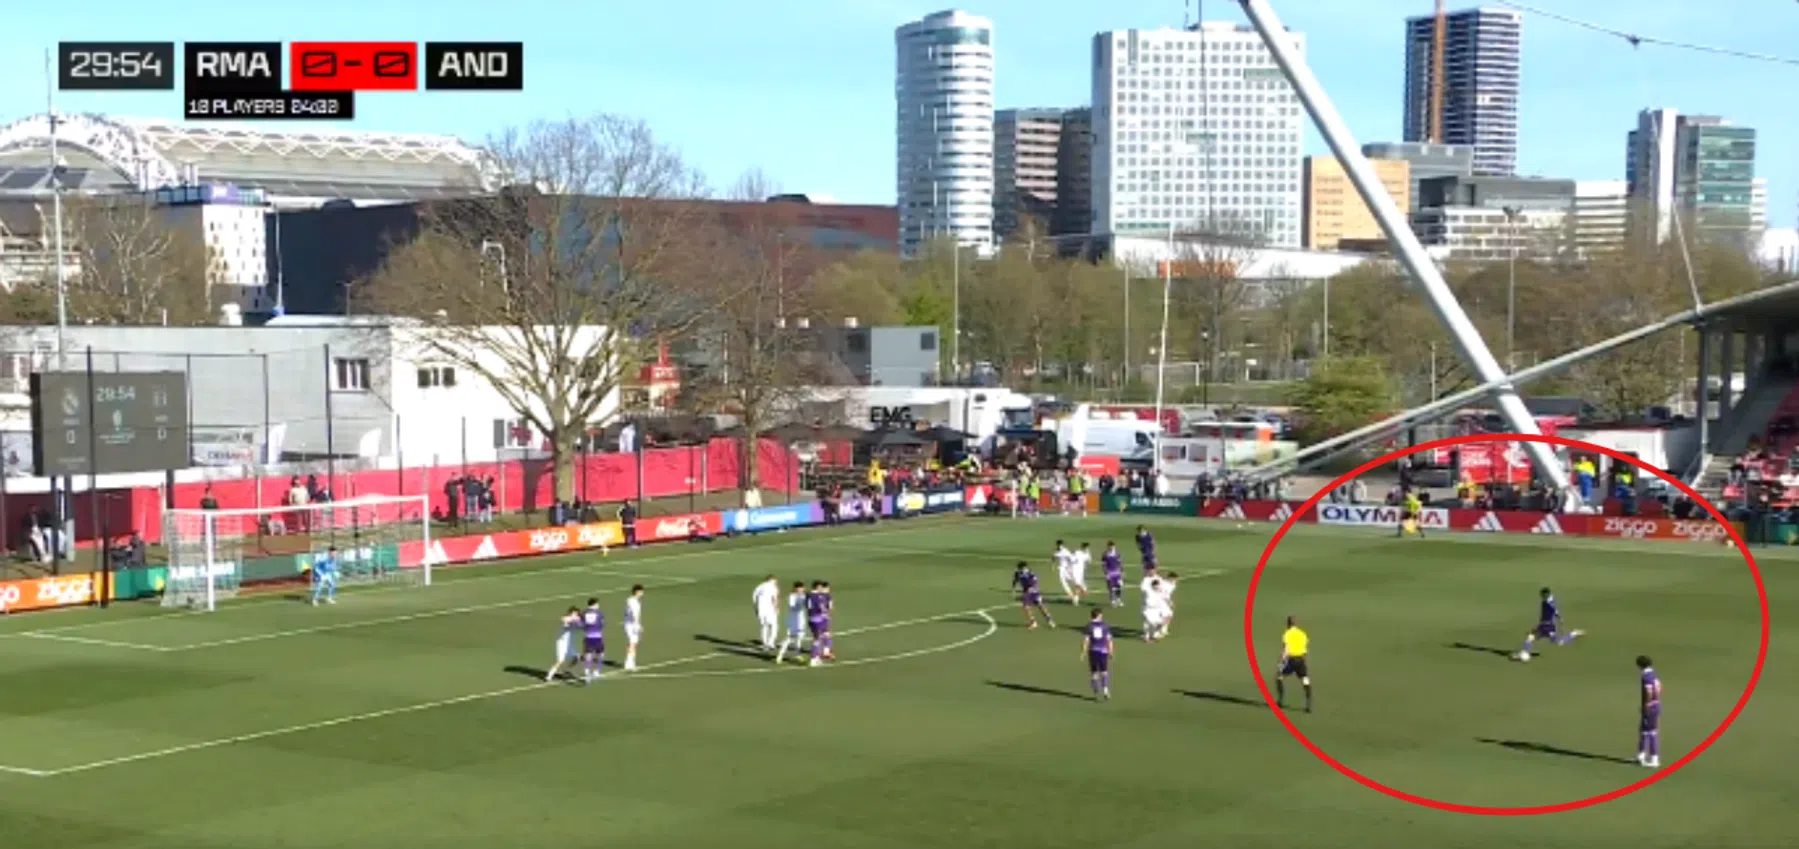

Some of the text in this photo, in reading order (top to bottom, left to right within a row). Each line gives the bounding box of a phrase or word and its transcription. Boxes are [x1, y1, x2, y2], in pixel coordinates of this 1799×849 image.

[871, 406, 911, 422] EMG
[1322, 506, 1442, 525] OLYMIA
[1604, 517, 1657, 538] ziggo
[1672, 521, 1727, 541] ziggo
[529, 529, 568, 551] ziggo
